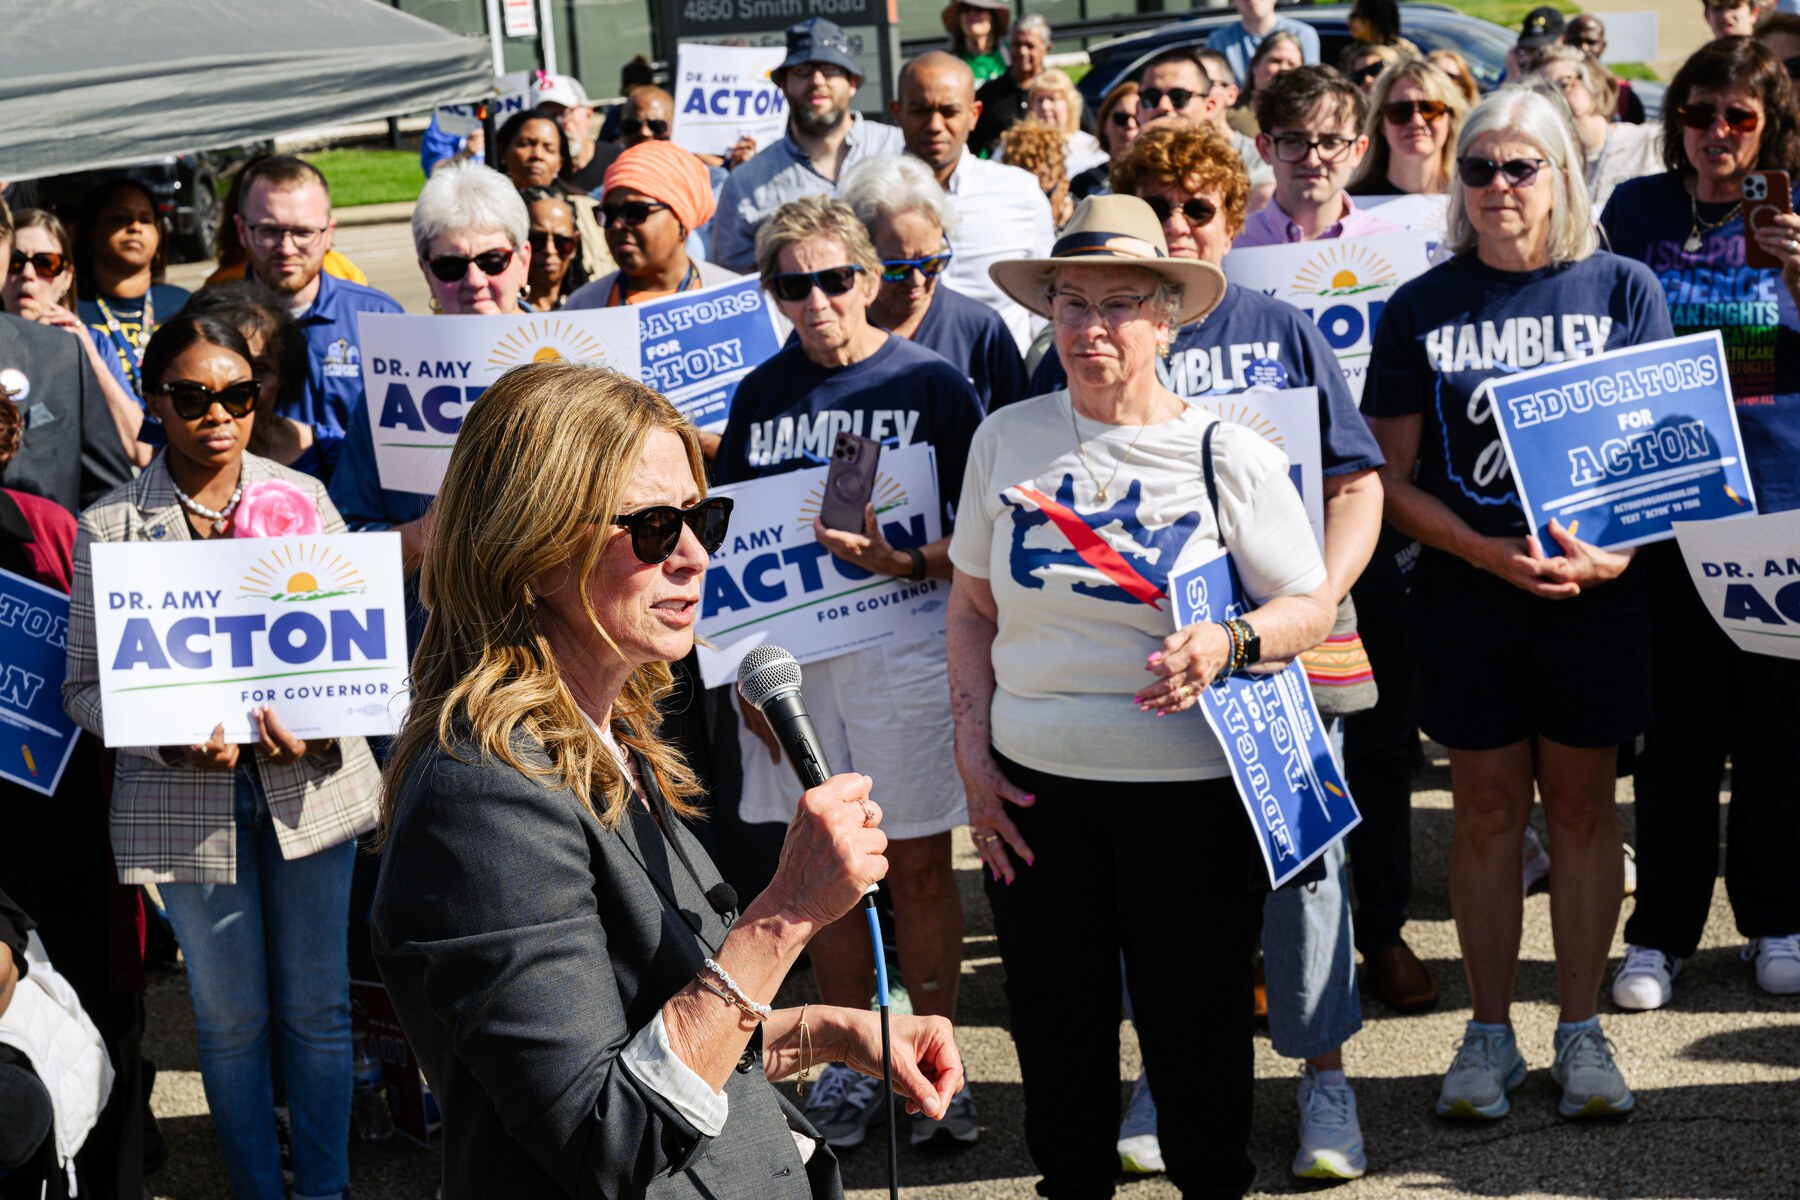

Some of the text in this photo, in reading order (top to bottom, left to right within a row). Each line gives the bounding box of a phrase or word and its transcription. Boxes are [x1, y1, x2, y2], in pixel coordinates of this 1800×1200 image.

[683, 0, 733, 21] 4850
[738, 0, 803, 19] Smith
[710, 74, 739, 84] AMY
[683, 87, 786, 116] ACTON
[1704, 301, 1780, 327] RIGHTS
[646, 339, 682, 361] FOR
[1426, 314, 1612, 373] HAMBLEY
[372, 357, 410, 377] DR.
[417, 360, 472, 379] AMY
[1508, 355, 1719, 429] EDUCATORS
[1617, 408, 1654, 431] FOR
[1567, 420, 1710, 487] ACTON
[733, 524, 783, 554] AMY
[1701, 562, 1754, 578] DR.
[108, 590, 223, 610] DR. AMY
[817, 606, 850, 623] FOR
[856, 580, 938, 613] GOVERNOR
[111, 608, 388, 671] ACTON
[241, 683, 389, 703] FOR GOVERNOR
[1240, 686, 1265, 734] FOR
